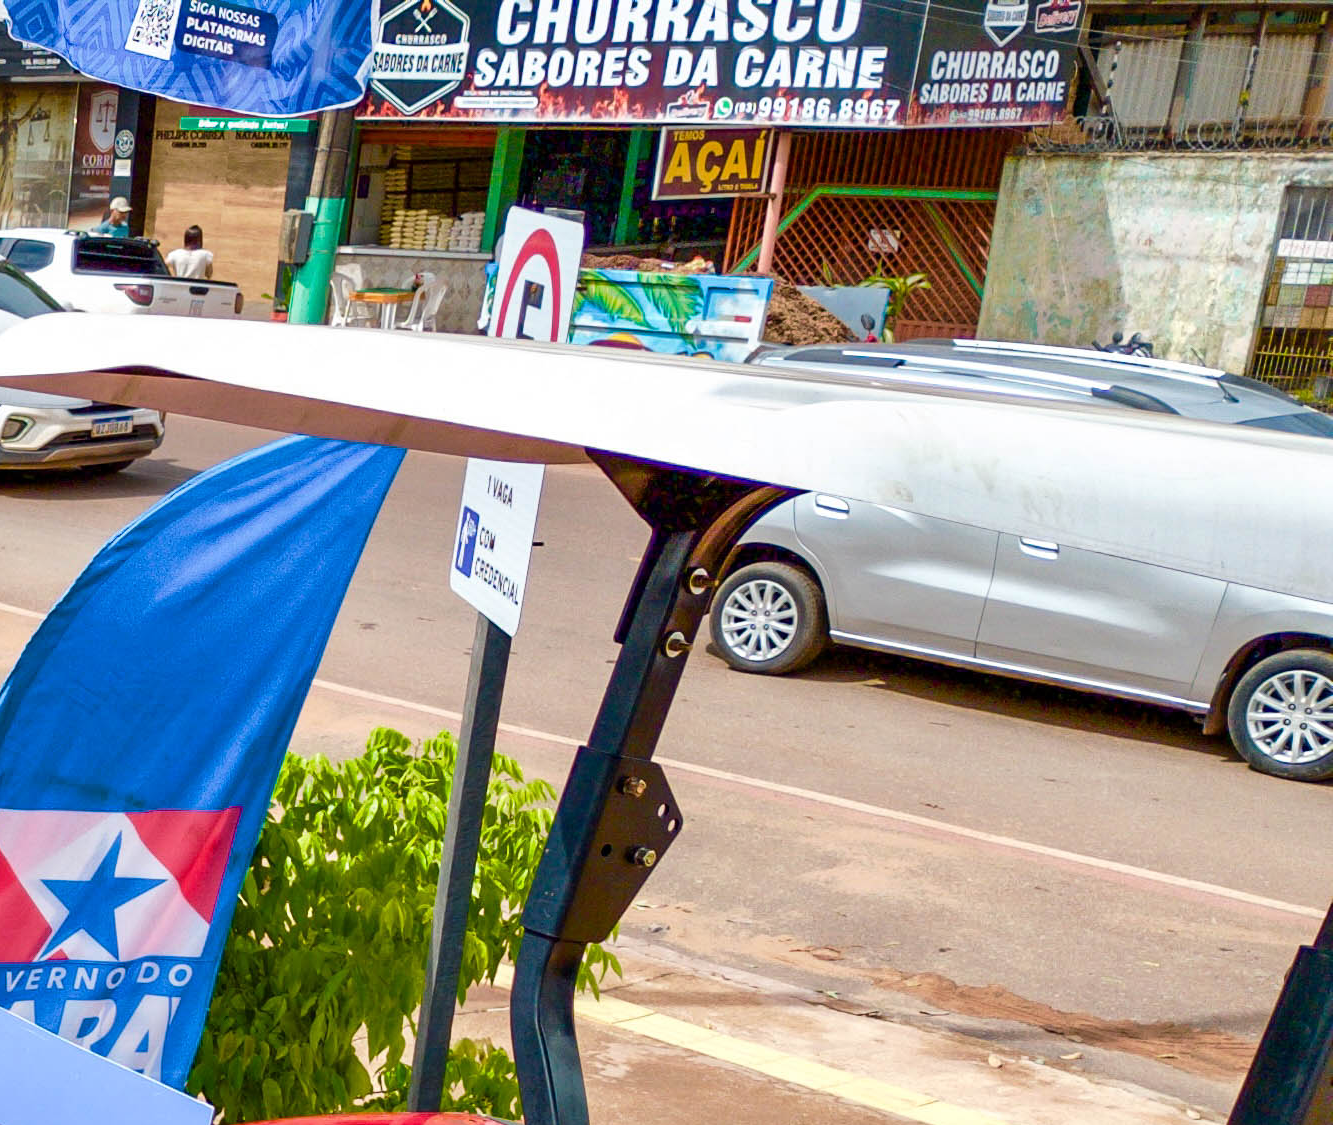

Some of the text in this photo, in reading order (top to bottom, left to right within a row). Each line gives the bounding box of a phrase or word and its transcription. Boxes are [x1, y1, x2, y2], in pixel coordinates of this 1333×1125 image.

[189, 0, 260, 28] SIGA NOSSAS
[496, 0, 862, 46] CHURRASCO
[183, 33, 234, 55] DIGITAIS
[186, 16, 266, 47] PLATAFORMAS
[395, 34, 447, 45] CHURRASCO
[372, 52, 465, 73] SABORES DA CARNE
[475, 46, 888, 90] SABORES DA CARNE
[931, 50, 1060, 80] CHURRASCO
[920, 81, 1066, 104] SABORES DA CARNE
[759, 97, 902, 121] 99186.8967
[673, 130, 705, 141] TEMOS
[663, 129, 767, 193] AÇAÍ
[493, 477, 514, 509] VAGA
[480, 527, 496, 552] COM
[474, 557, 519, 606] CREDENCIAL
[137, 962, 193, 987] DO
